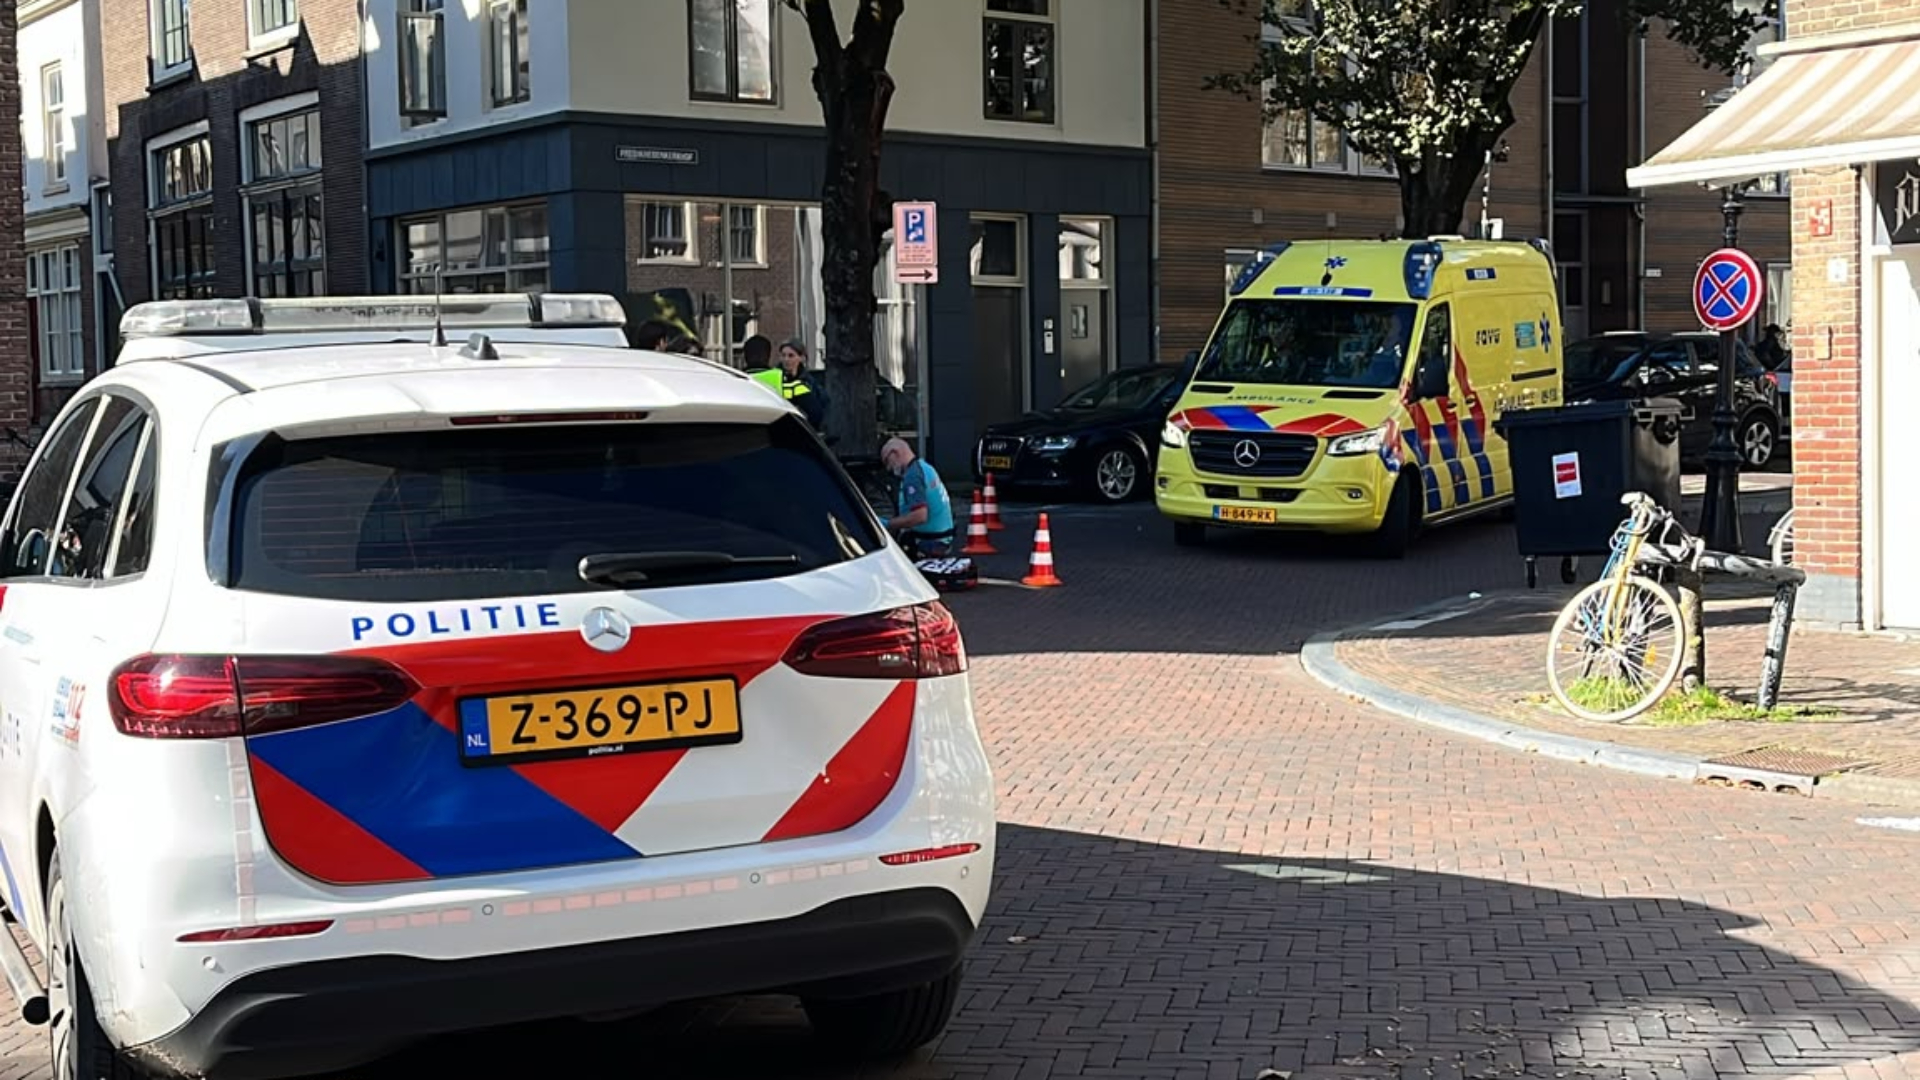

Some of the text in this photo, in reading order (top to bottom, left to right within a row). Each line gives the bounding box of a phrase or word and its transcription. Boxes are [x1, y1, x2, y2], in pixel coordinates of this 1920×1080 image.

[351, 603, 560, 641] POLITIE
[509, 688, 713, 745] Z-369-PJ
[466, 734, 488, 748] NL
